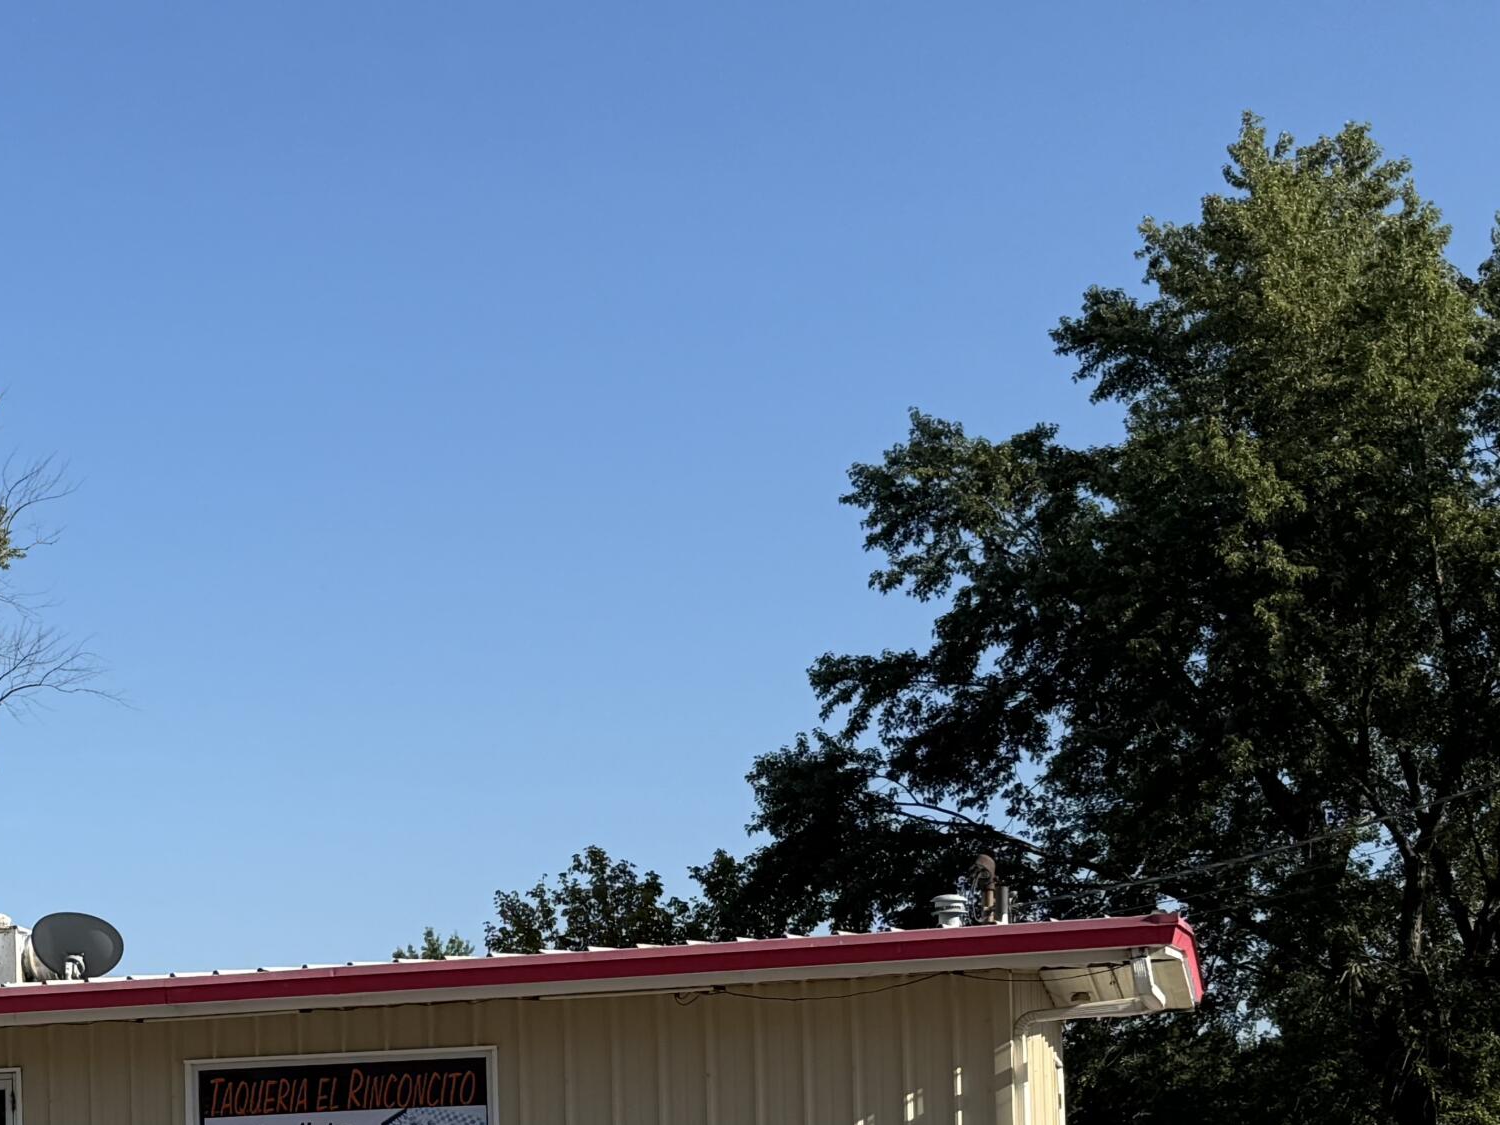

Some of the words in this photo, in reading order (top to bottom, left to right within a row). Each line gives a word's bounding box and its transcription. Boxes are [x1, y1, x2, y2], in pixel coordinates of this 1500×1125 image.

[210, 1078, 308, 1117] TAQUERIA
[317, 1077, 339, 1112] EL
[349, 1068, 476, 1110] RINCONCITO
